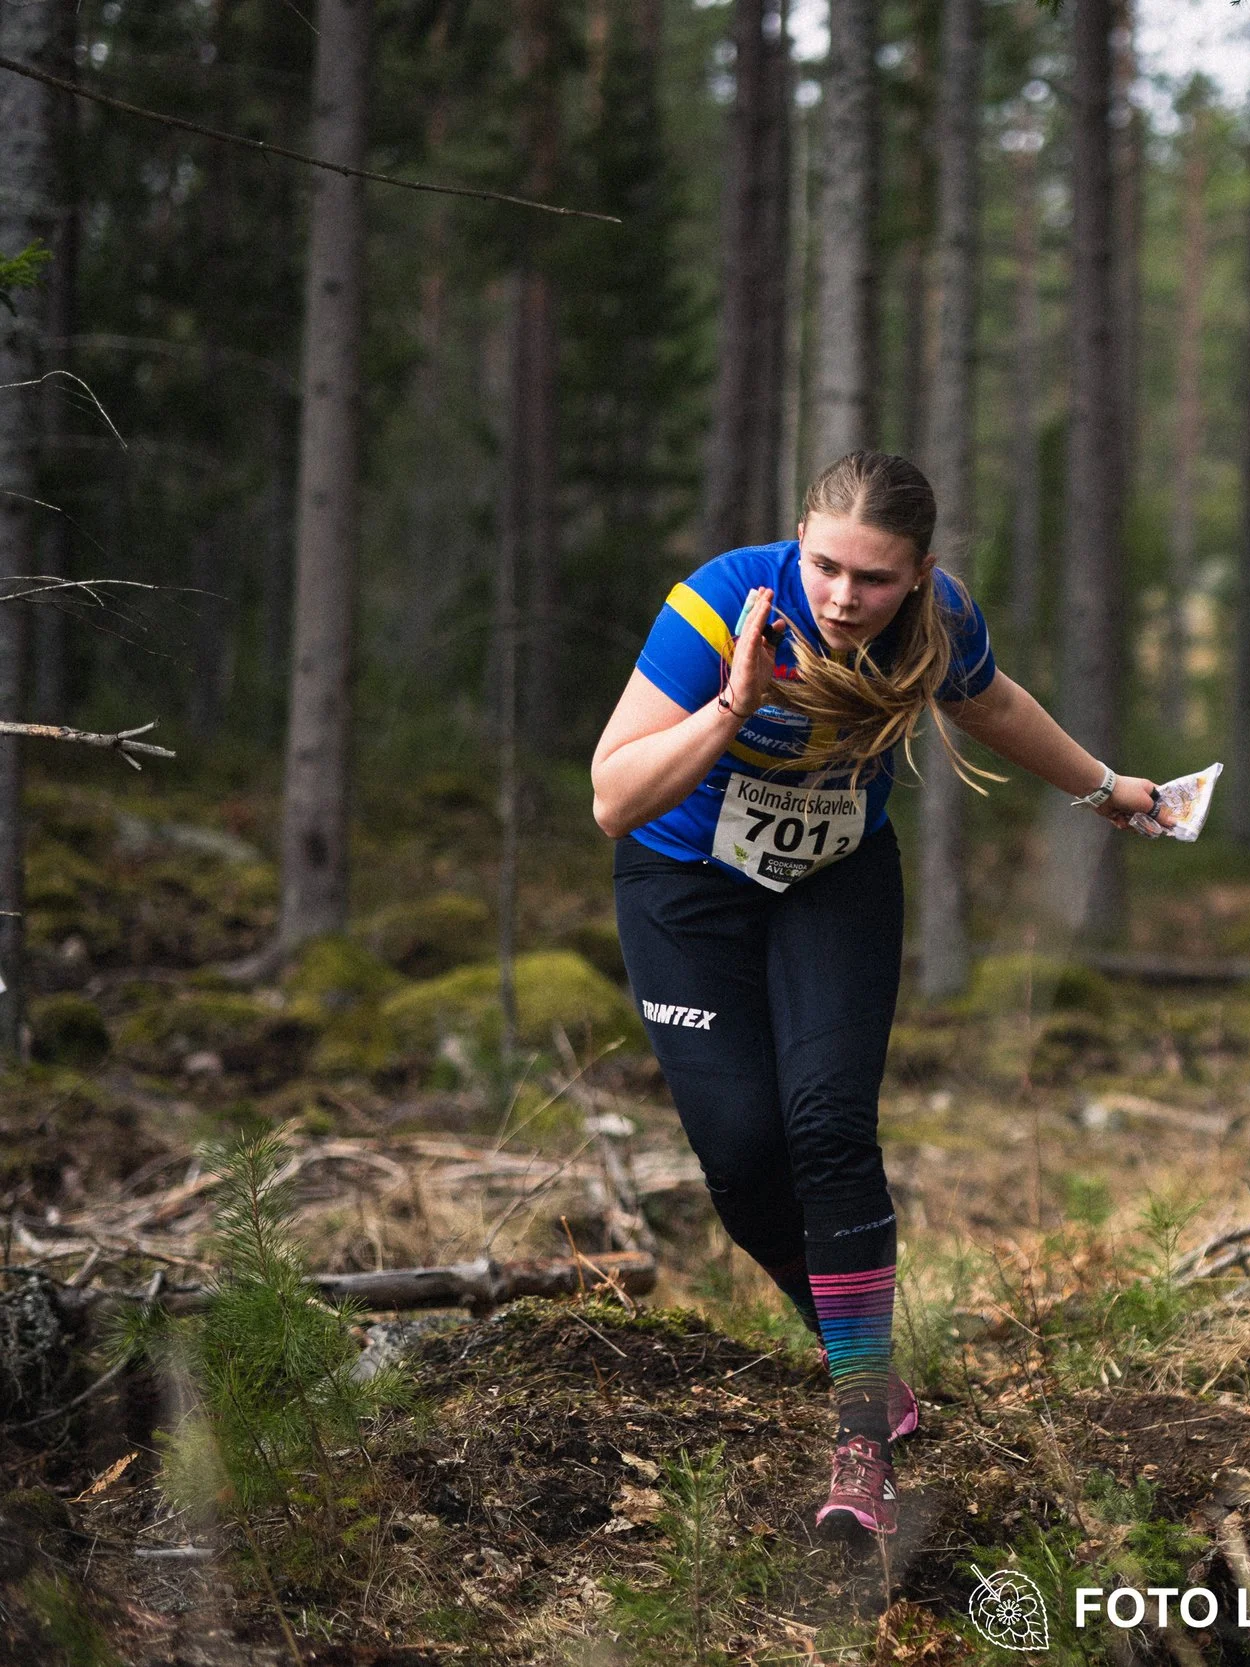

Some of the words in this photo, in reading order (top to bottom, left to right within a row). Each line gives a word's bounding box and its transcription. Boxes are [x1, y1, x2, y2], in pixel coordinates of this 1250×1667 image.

[745, 807, 830, 855] 701
[833, 836, 850, 856] 2
[642, 1000, 717, 1030] TRIMTEX
